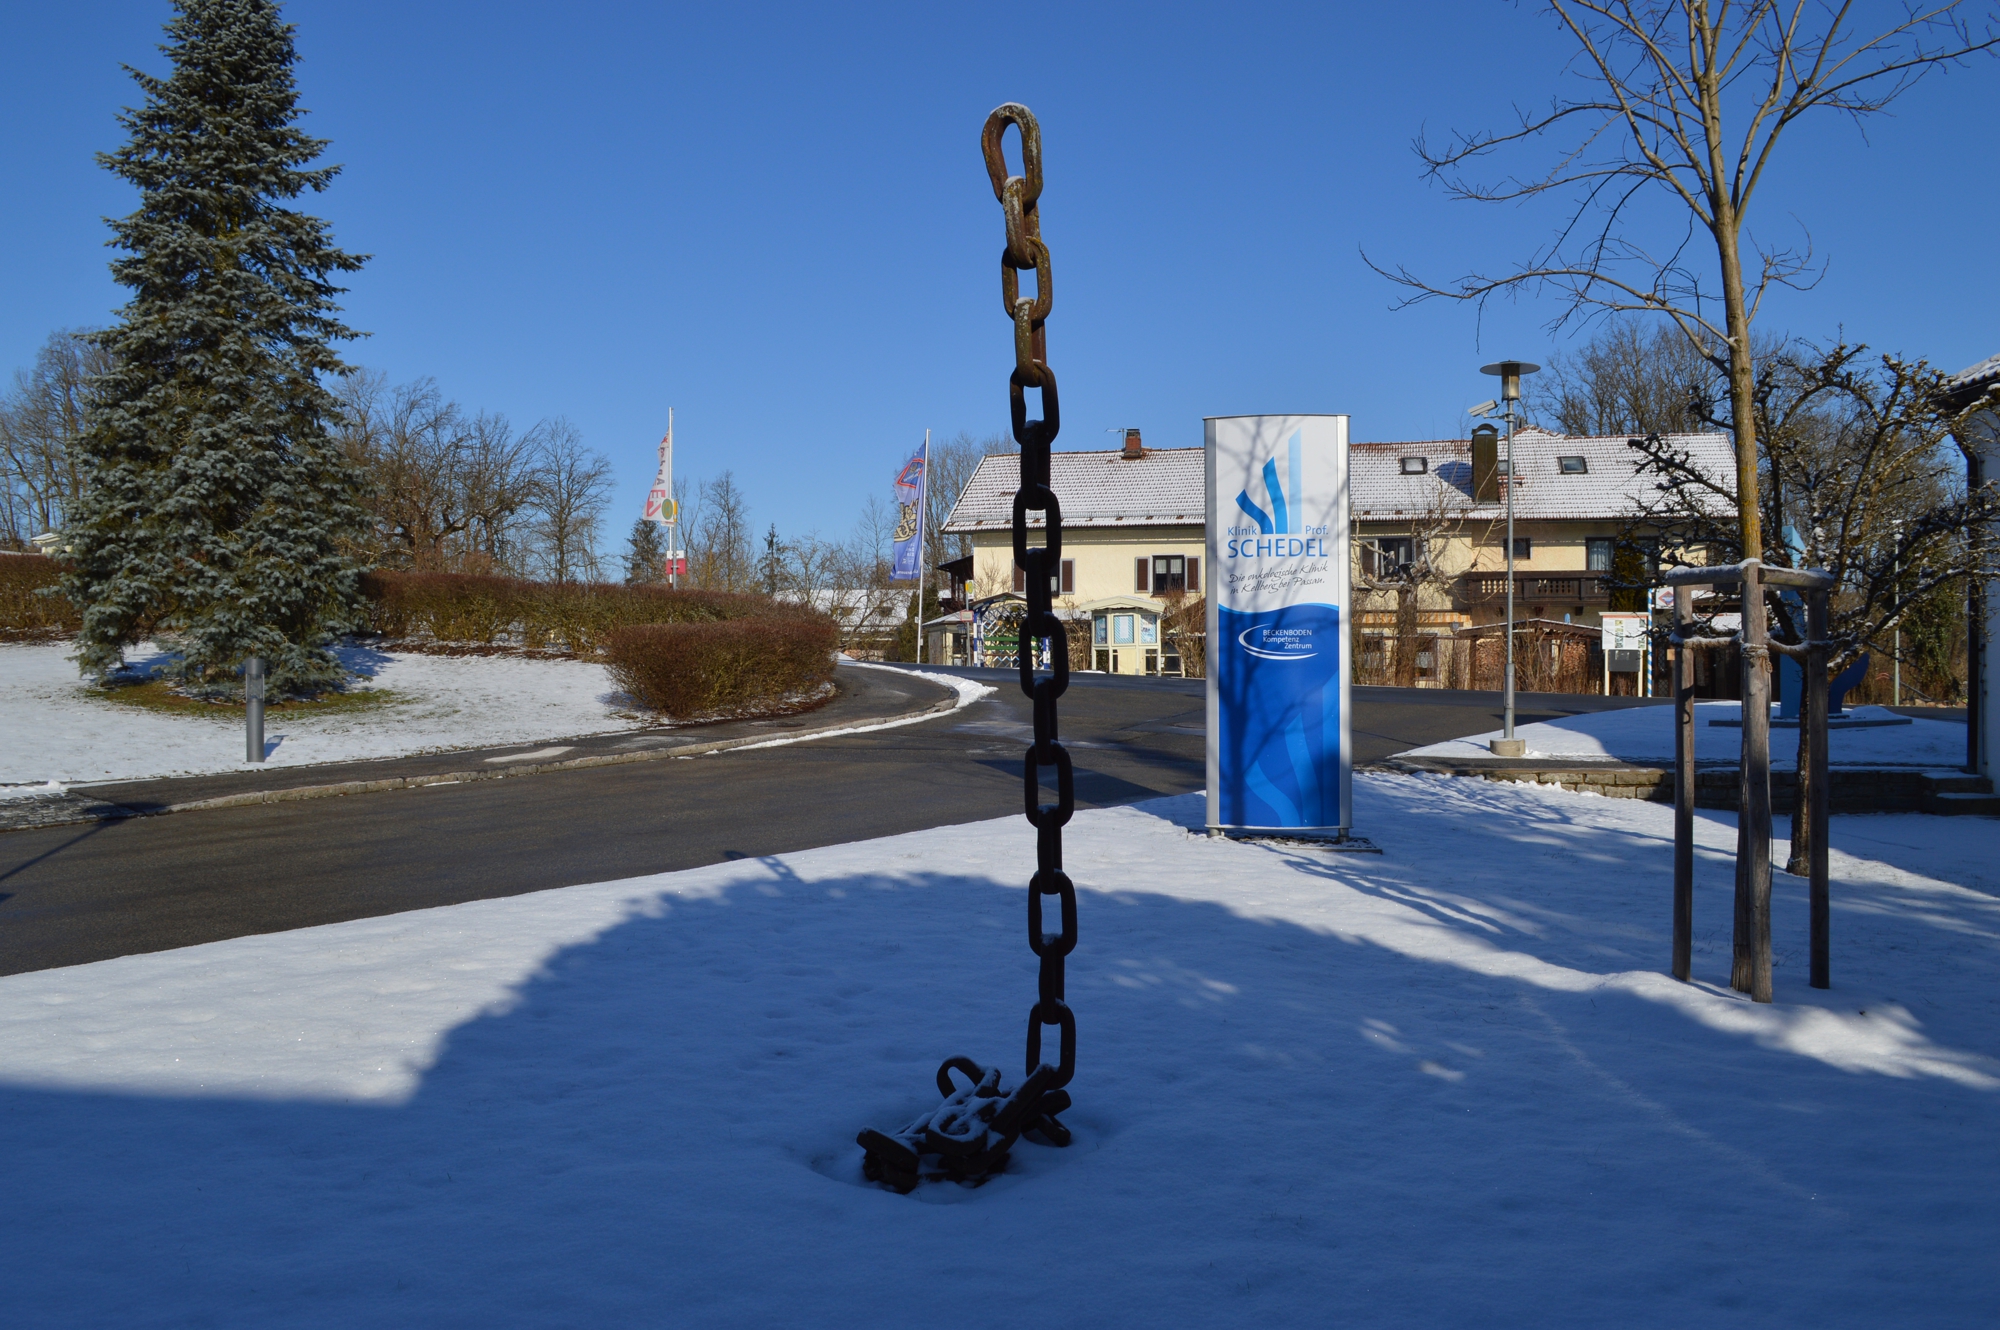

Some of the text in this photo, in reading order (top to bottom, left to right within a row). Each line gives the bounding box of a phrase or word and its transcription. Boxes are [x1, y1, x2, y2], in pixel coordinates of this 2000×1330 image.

[1227, 525, 1329, 536] Klinik Prof.
[1227, 538, 1329, 558] SCHEDEL
[1229, 561, 1328, 584] Die onkologische Klinik
[1230, 587, 1239, 595] in
[1241, 580, 1279, 594] Kellberg
[1279, 579, 1291, 587] bei
[1262, 636, 1300, 644] Kompetenz
